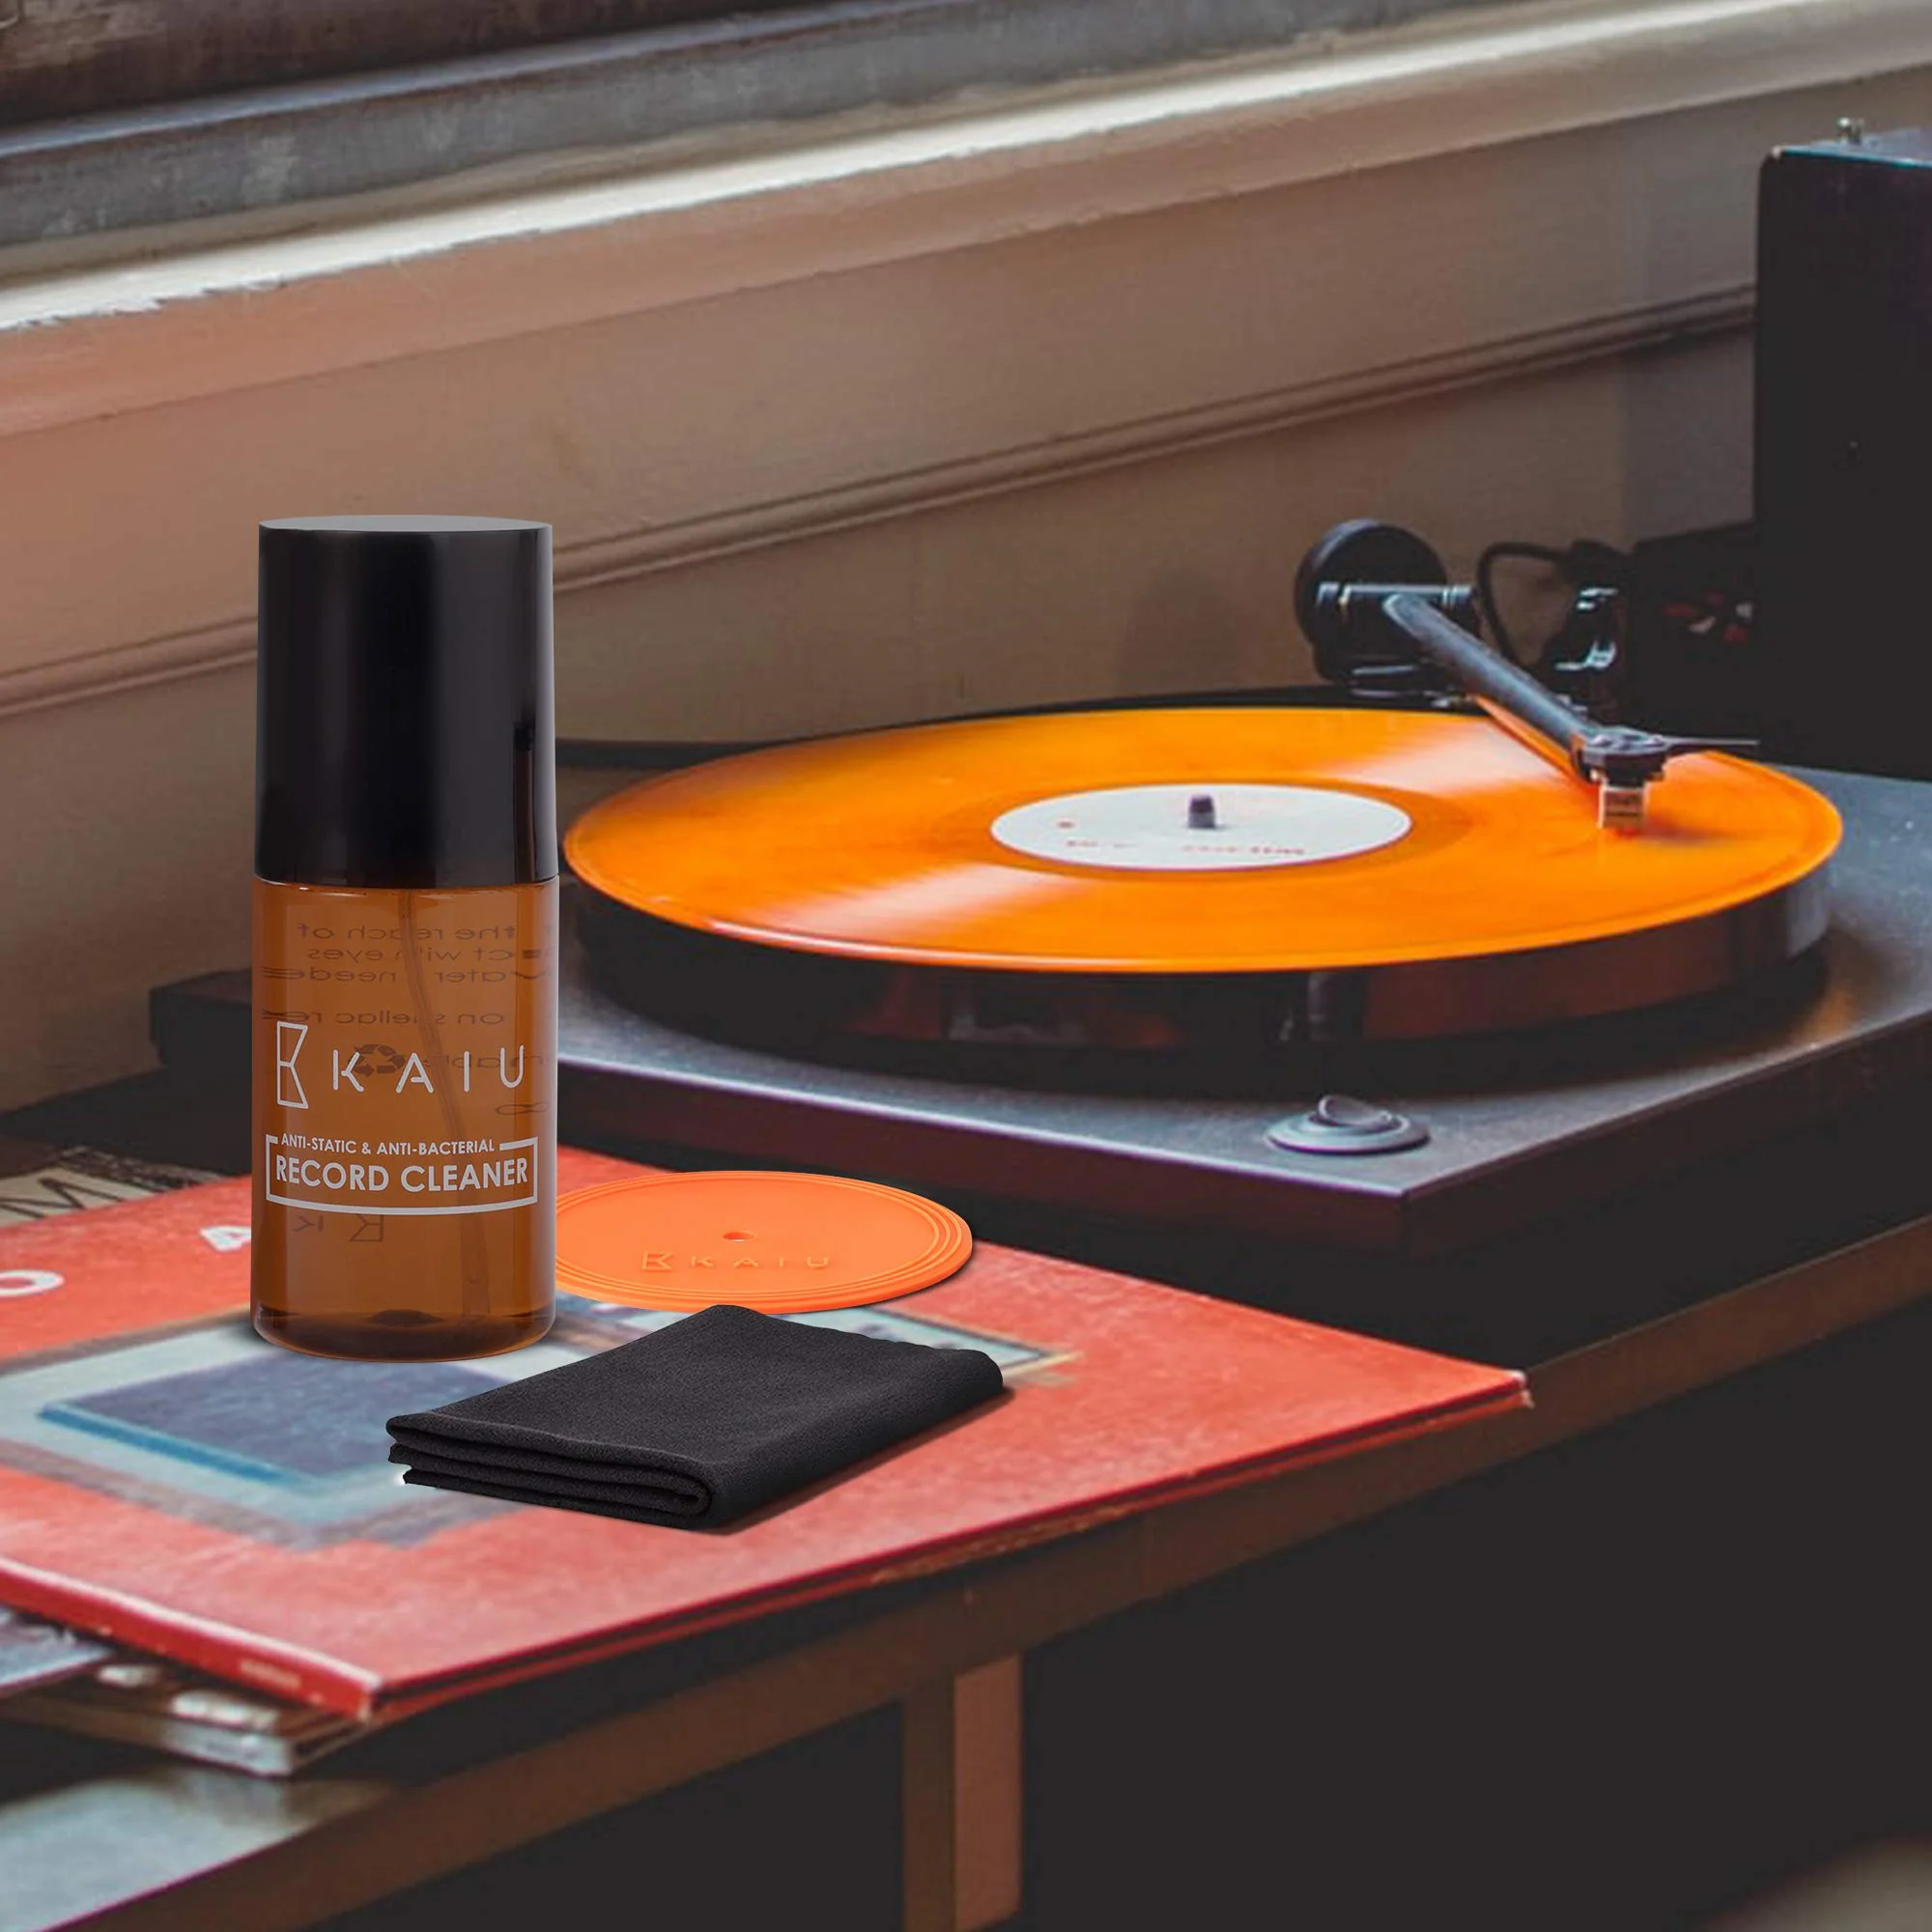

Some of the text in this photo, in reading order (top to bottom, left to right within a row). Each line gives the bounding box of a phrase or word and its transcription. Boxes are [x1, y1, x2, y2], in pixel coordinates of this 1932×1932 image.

[332, 1044, 525, 1093] KAIU
[281, 1132, 496, 1156] ANTI-STATIC & ANTI-BACTERIAL
[275, 1154, 528, 1193] RECORD CLEANER
[690, 1255, 830, 1270] KAIU
